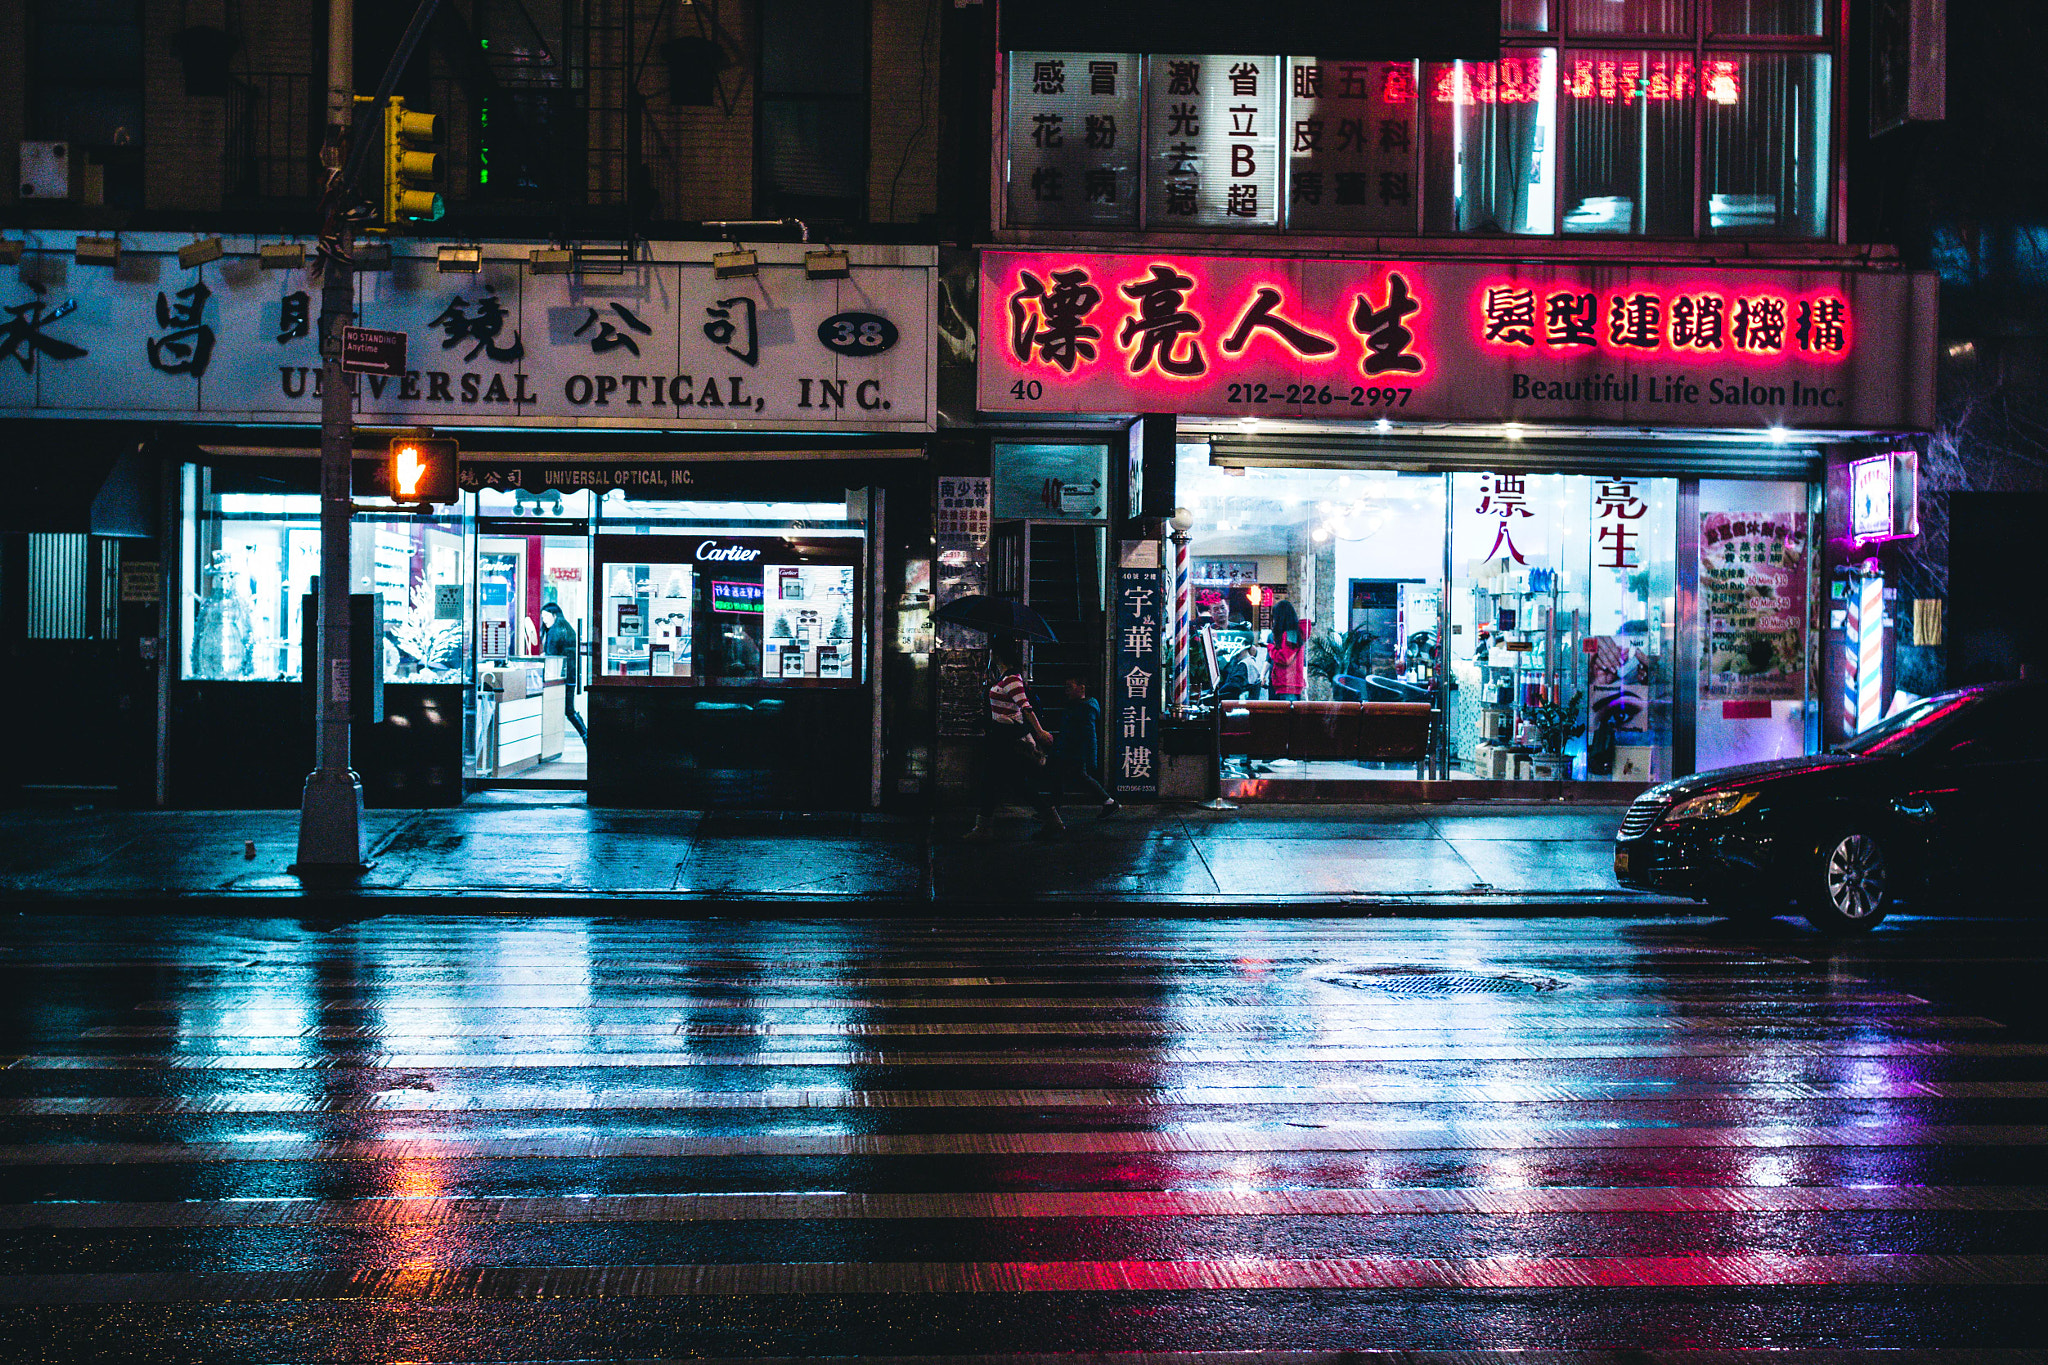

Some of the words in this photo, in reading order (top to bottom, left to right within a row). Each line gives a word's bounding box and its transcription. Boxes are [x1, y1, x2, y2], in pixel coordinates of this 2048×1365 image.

[1227, 62, 1258, 218] 省立B超
[1010, 264, 1426, 377] 漂亮人生
[1485, 288, 1846, 352] 髮型連鎖機構
[347, 332, 358, 341] NO
[360, 333, 397, 345] STANDING
[832, 321, 884, 347] 38
[347, 342, 378, 353] Anytime
[280, 366, 537, 404] UVERSAL
[565, 373, 764, 412] OPTICAL,
[797, 377, 891, 411] INC.
[1010, 379, 1043, 401] 40
[1227, 383, 1413, 408] 212-226-2997
[1512, 373, 1638, 402] Beautiful
[1649, 374, 1700, 405] Life
[1709, 375, 1786, 407] Salon
[1793, 381, 1845, 409] Inc.
[545, 470, 610, 486] UNIVERSAL
[614, 470, 668, 488] OPTICAL,
[671, 471, 694, 485] INC.
[941, 481, 988, 498] 南少林
[696, 540, 761, 562] Cartier
[1711, 581, 1728, 591] Foot
[1730, 581, 1745, 590] Rub
[1712, 606, 1731, 614] Back
[1732, 606, 1748, 614] Rub
[1121, 585, 1154, 778] 宇華會計樓
